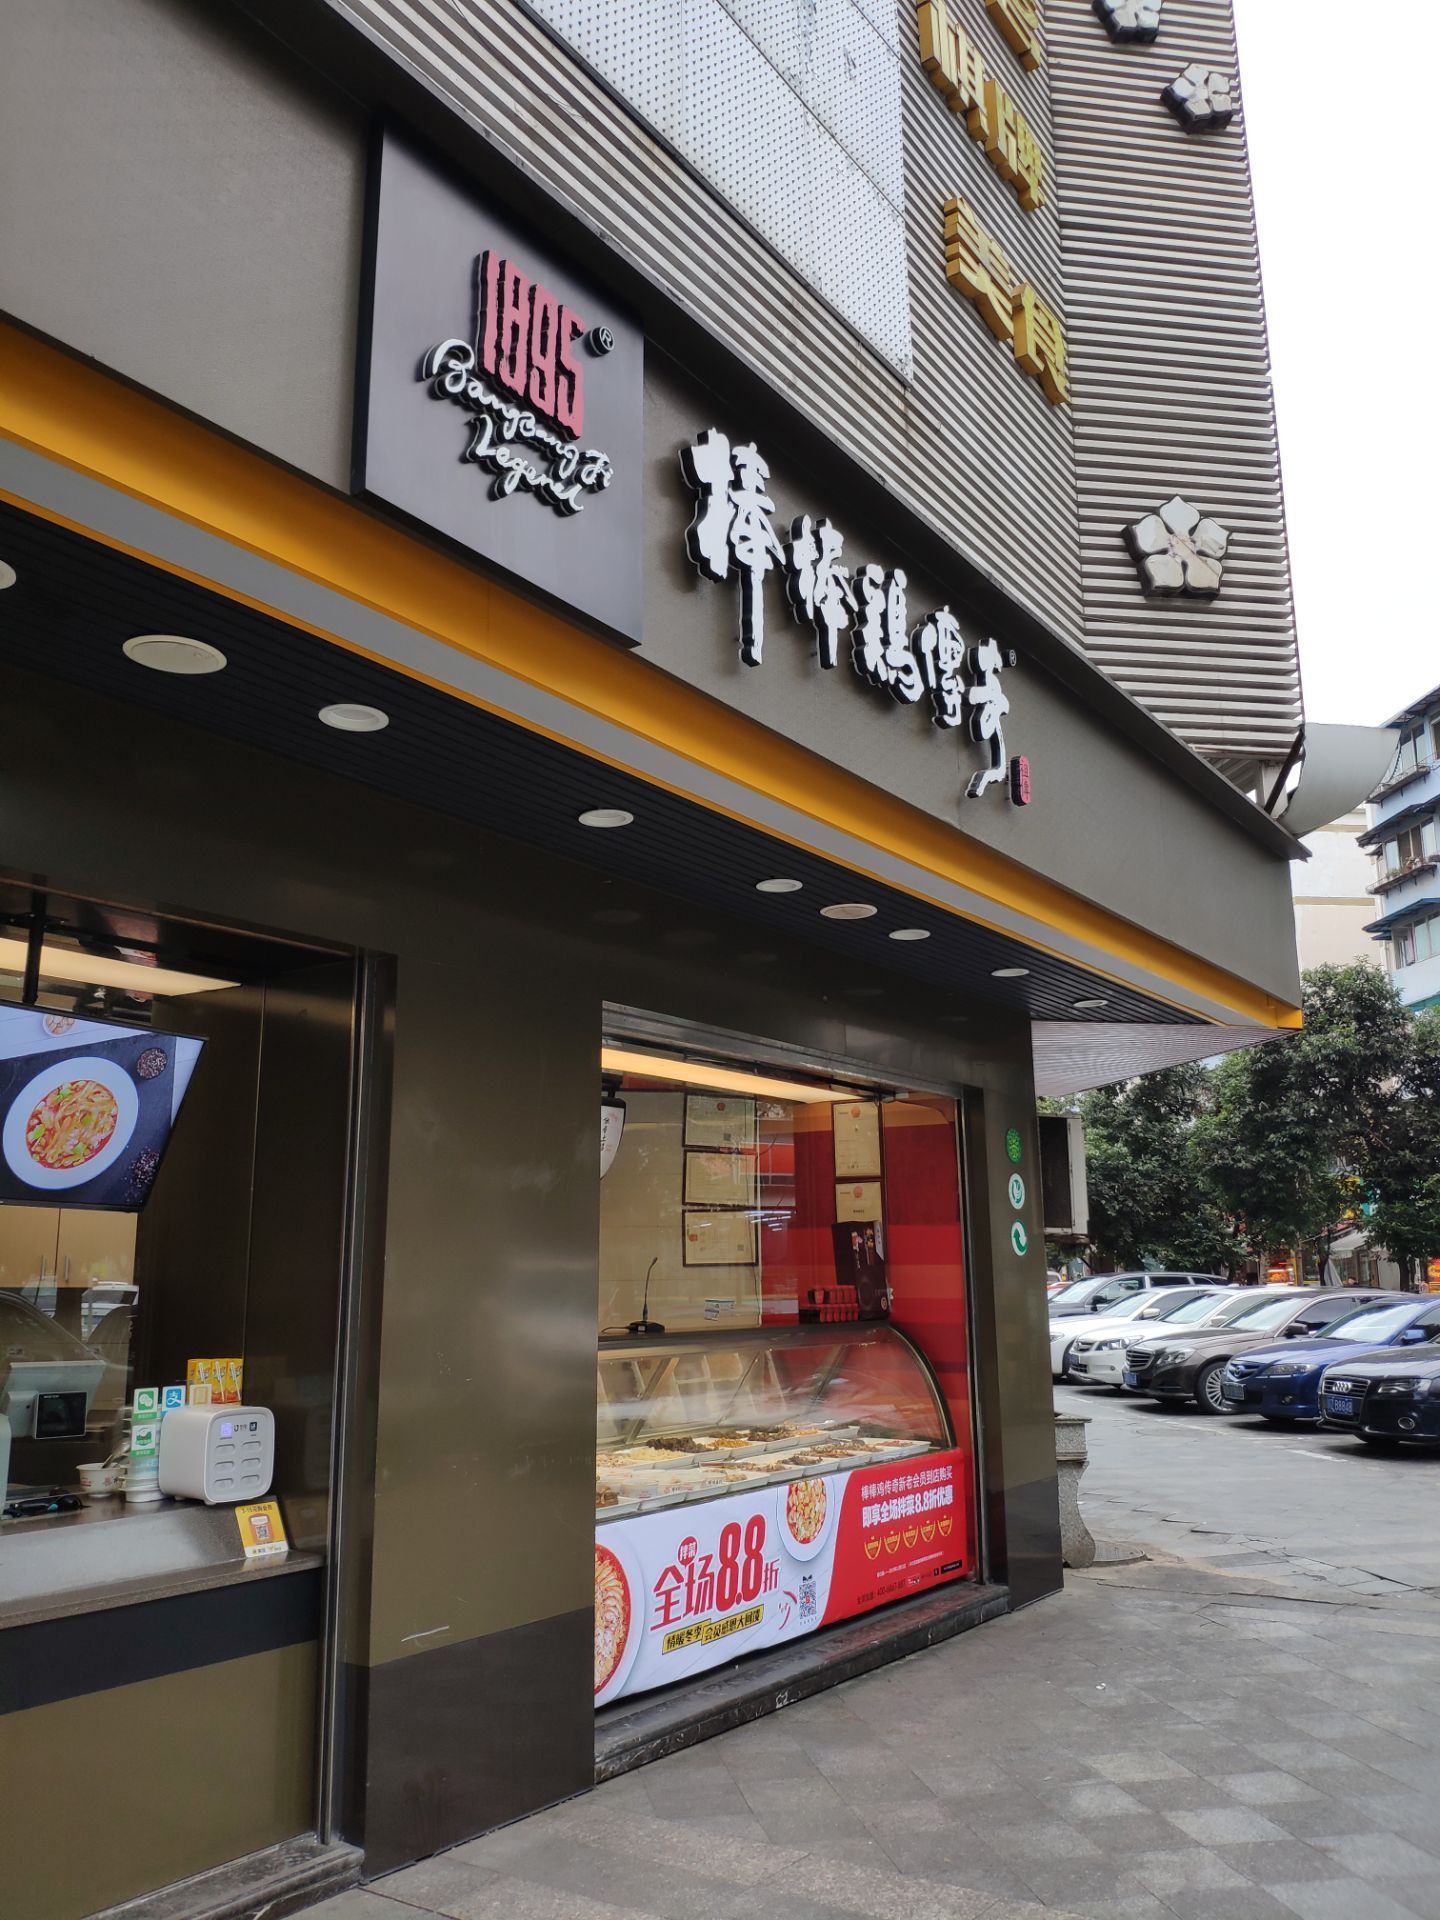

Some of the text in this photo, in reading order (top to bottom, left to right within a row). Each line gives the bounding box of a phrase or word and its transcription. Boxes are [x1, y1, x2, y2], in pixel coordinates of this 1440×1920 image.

[479, 249, 587, 438] 1895
[944, 196, 1070, 405] 美食
[464, 413, 584, 512] Legend
[861, 1466, 952, 1501] 棒棒鸡传奇新老会员到店购买
[862, 1485, 953, 1528] 即享全场拌菜8.8折优惠
